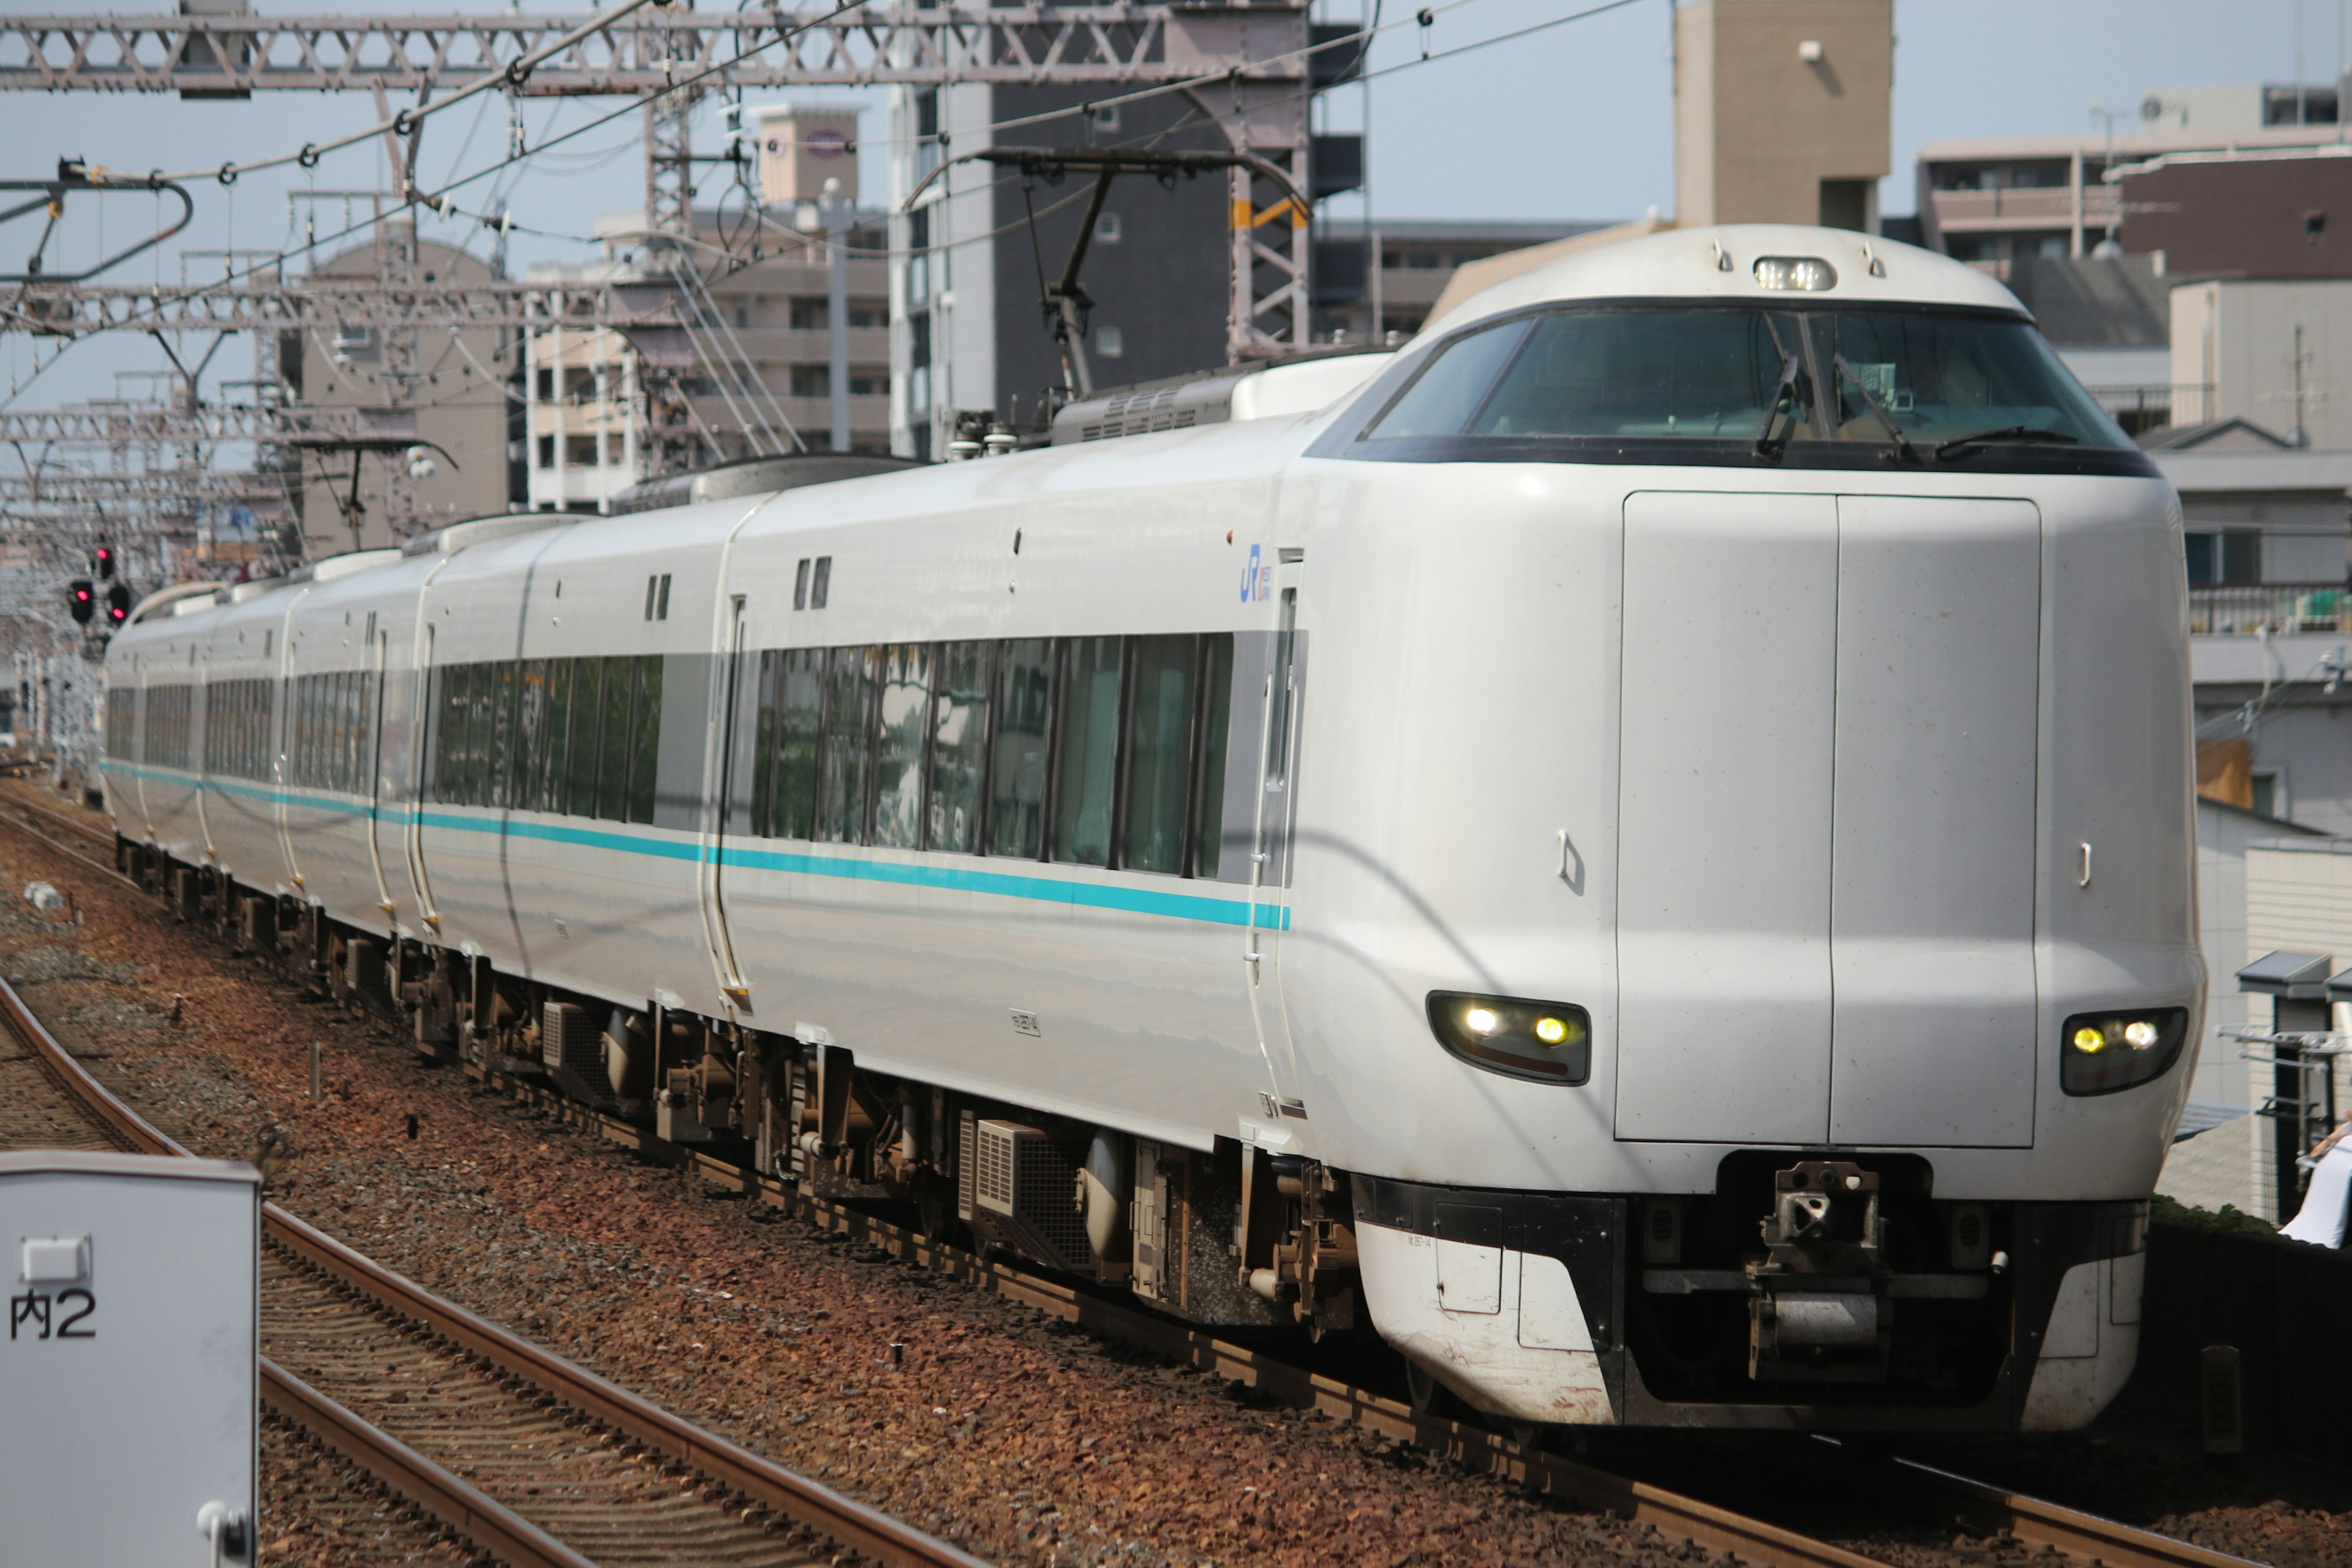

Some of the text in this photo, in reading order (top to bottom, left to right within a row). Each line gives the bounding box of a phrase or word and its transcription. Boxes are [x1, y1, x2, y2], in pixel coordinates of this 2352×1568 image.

[1240, 543, 1260, 603] JR
[11, 1287, 96, 1340] 内2
[2209, 1368, 2235, 1434] 1000
